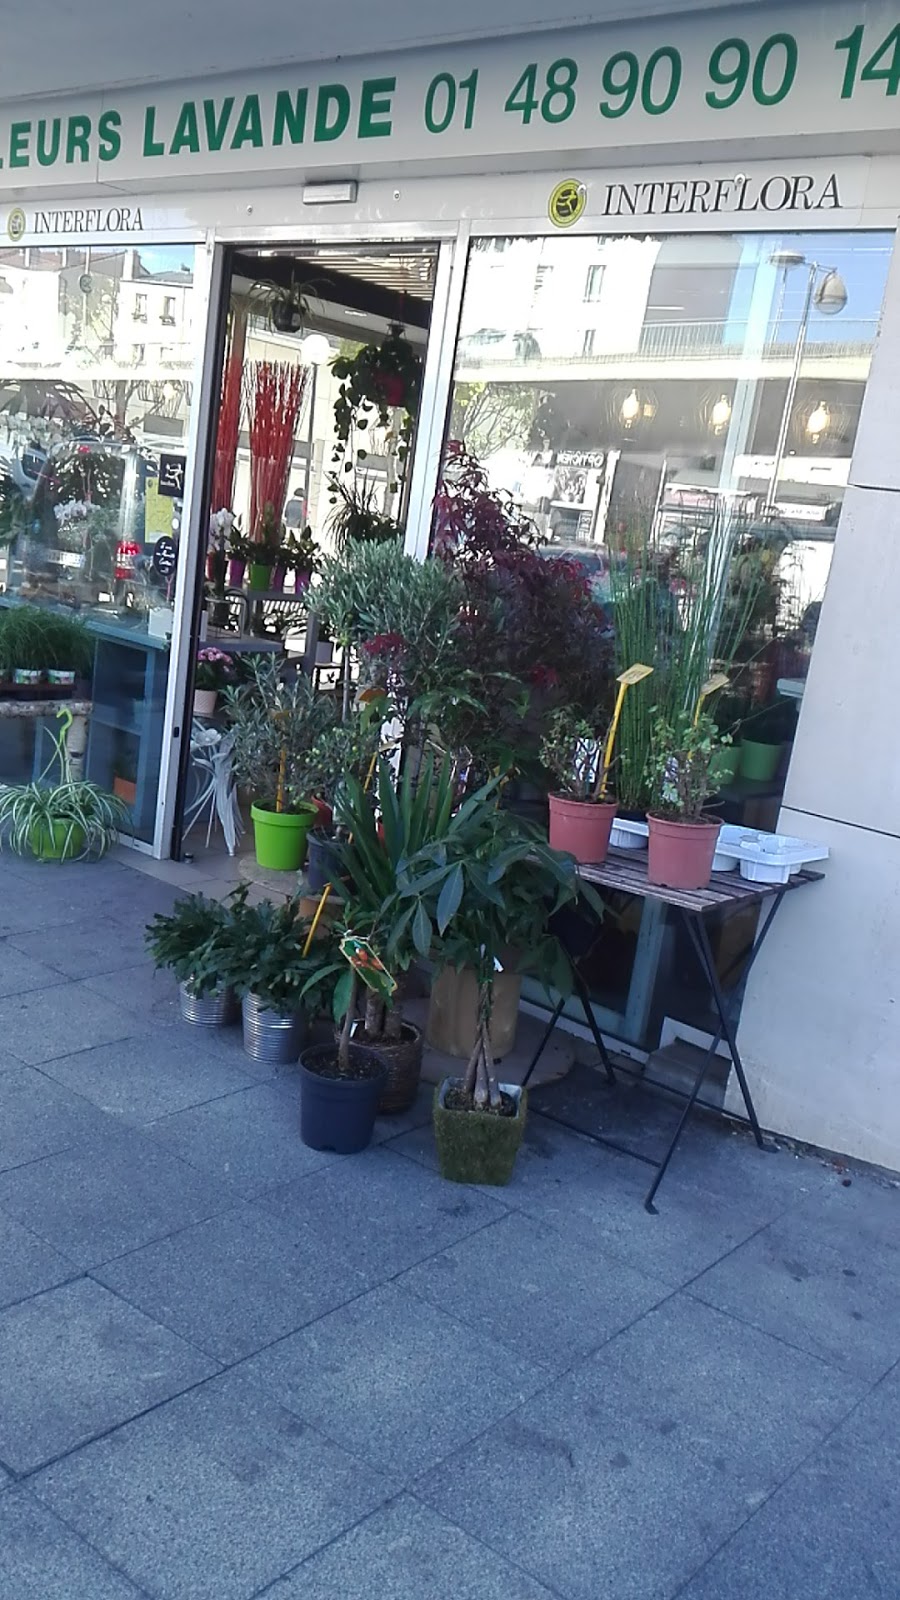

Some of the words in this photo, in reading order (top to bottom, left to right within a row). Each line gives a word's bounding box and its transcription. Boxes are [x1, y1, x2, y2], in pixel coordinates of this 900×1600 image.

[0, 109, 121, 169] EURS
[143, 77, 397, 158] LAVANDE
[424, 69, 479, 134] 01
[504, 57, 579, 125] 48
[600, 46, 682, 119] 90
[705, 32, 799, 110] 90
[834, 22, 900, 100] 14
[601, 174, 843, 217] INTERFLORA
[33, 207, 144, 234] INTERFLORA
